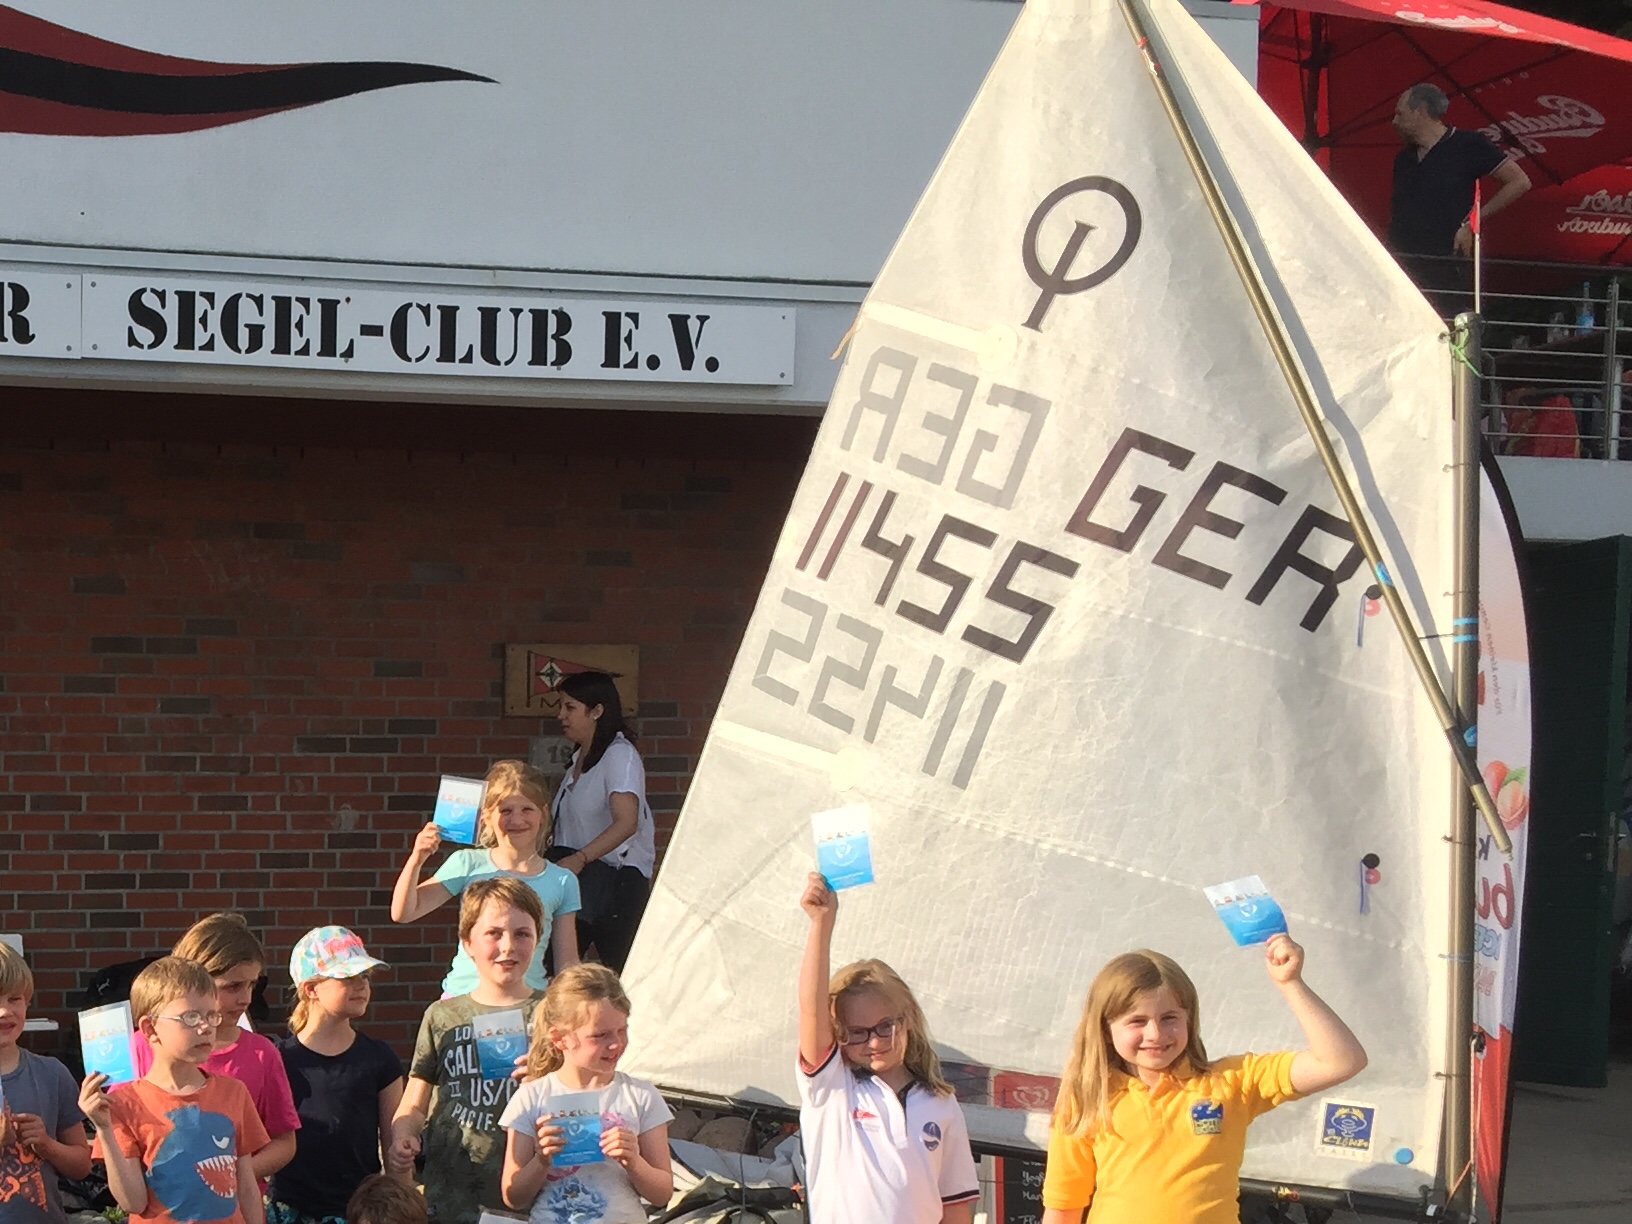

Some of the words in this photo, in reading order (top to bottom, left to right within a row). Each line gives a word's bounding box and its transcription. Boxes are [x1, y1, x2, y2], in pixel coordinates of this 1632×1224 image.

[127, 286, 573, 367] SEGEL-CLUB
[600, 310, 721, 373] E.V.
[1064, 426, 1368, 633] GER
